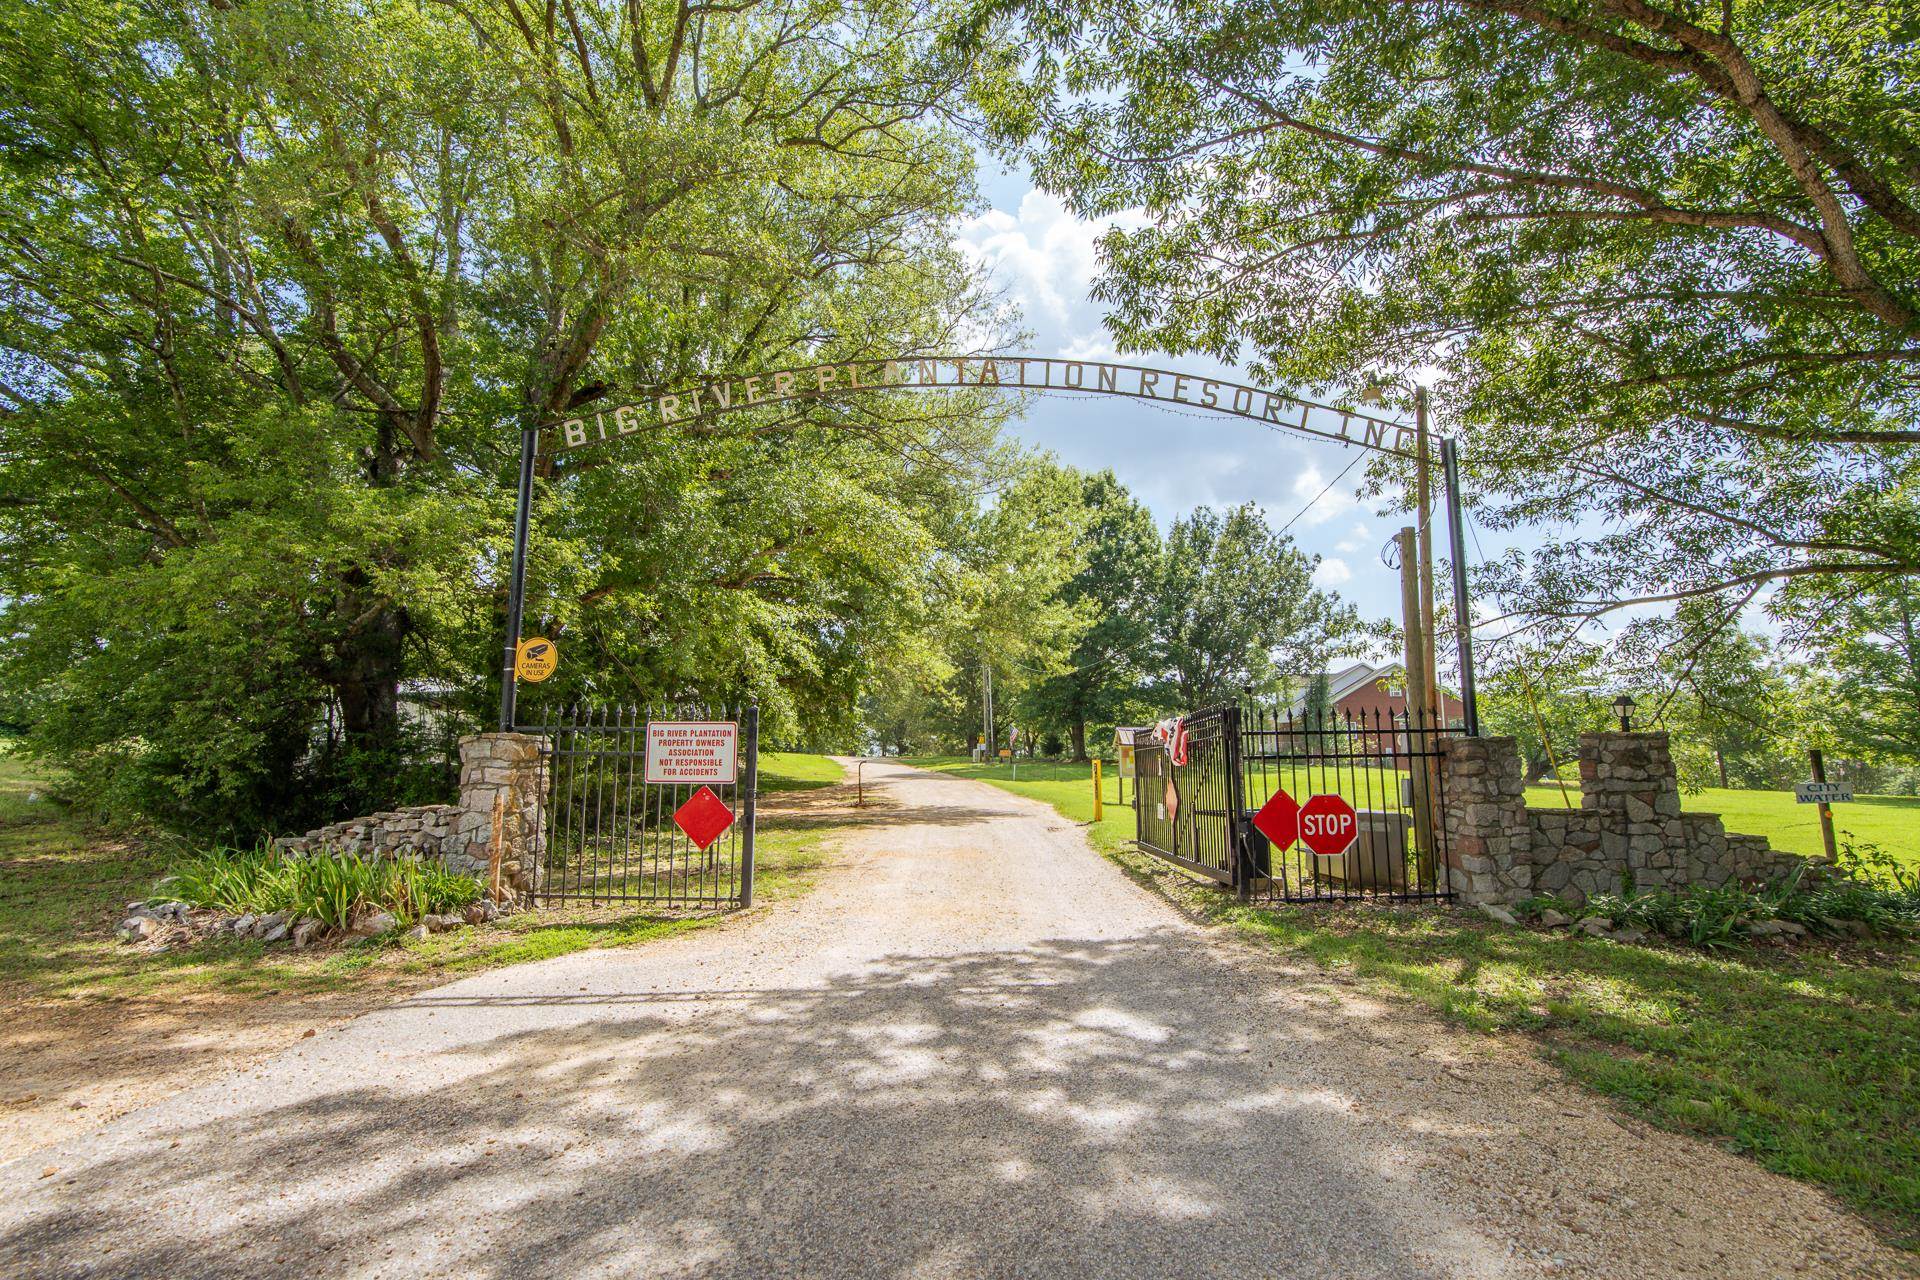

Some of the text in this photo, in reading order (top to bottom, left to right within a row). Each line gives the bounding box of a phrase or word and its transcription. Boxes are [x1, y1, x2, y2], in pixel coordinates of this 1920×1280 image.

[564, 406, 639, 448] BIG
[659, 371, 795, 424] RIVER
[816, 358, 1118, 393] PLANTATION
[1139, 368, 1317, 429] RESORT
[1807, 784, 1840, 792] CITY
[1799, 793, 1851, 802] WATER
[1304, 814, 1352, 836] STOP
